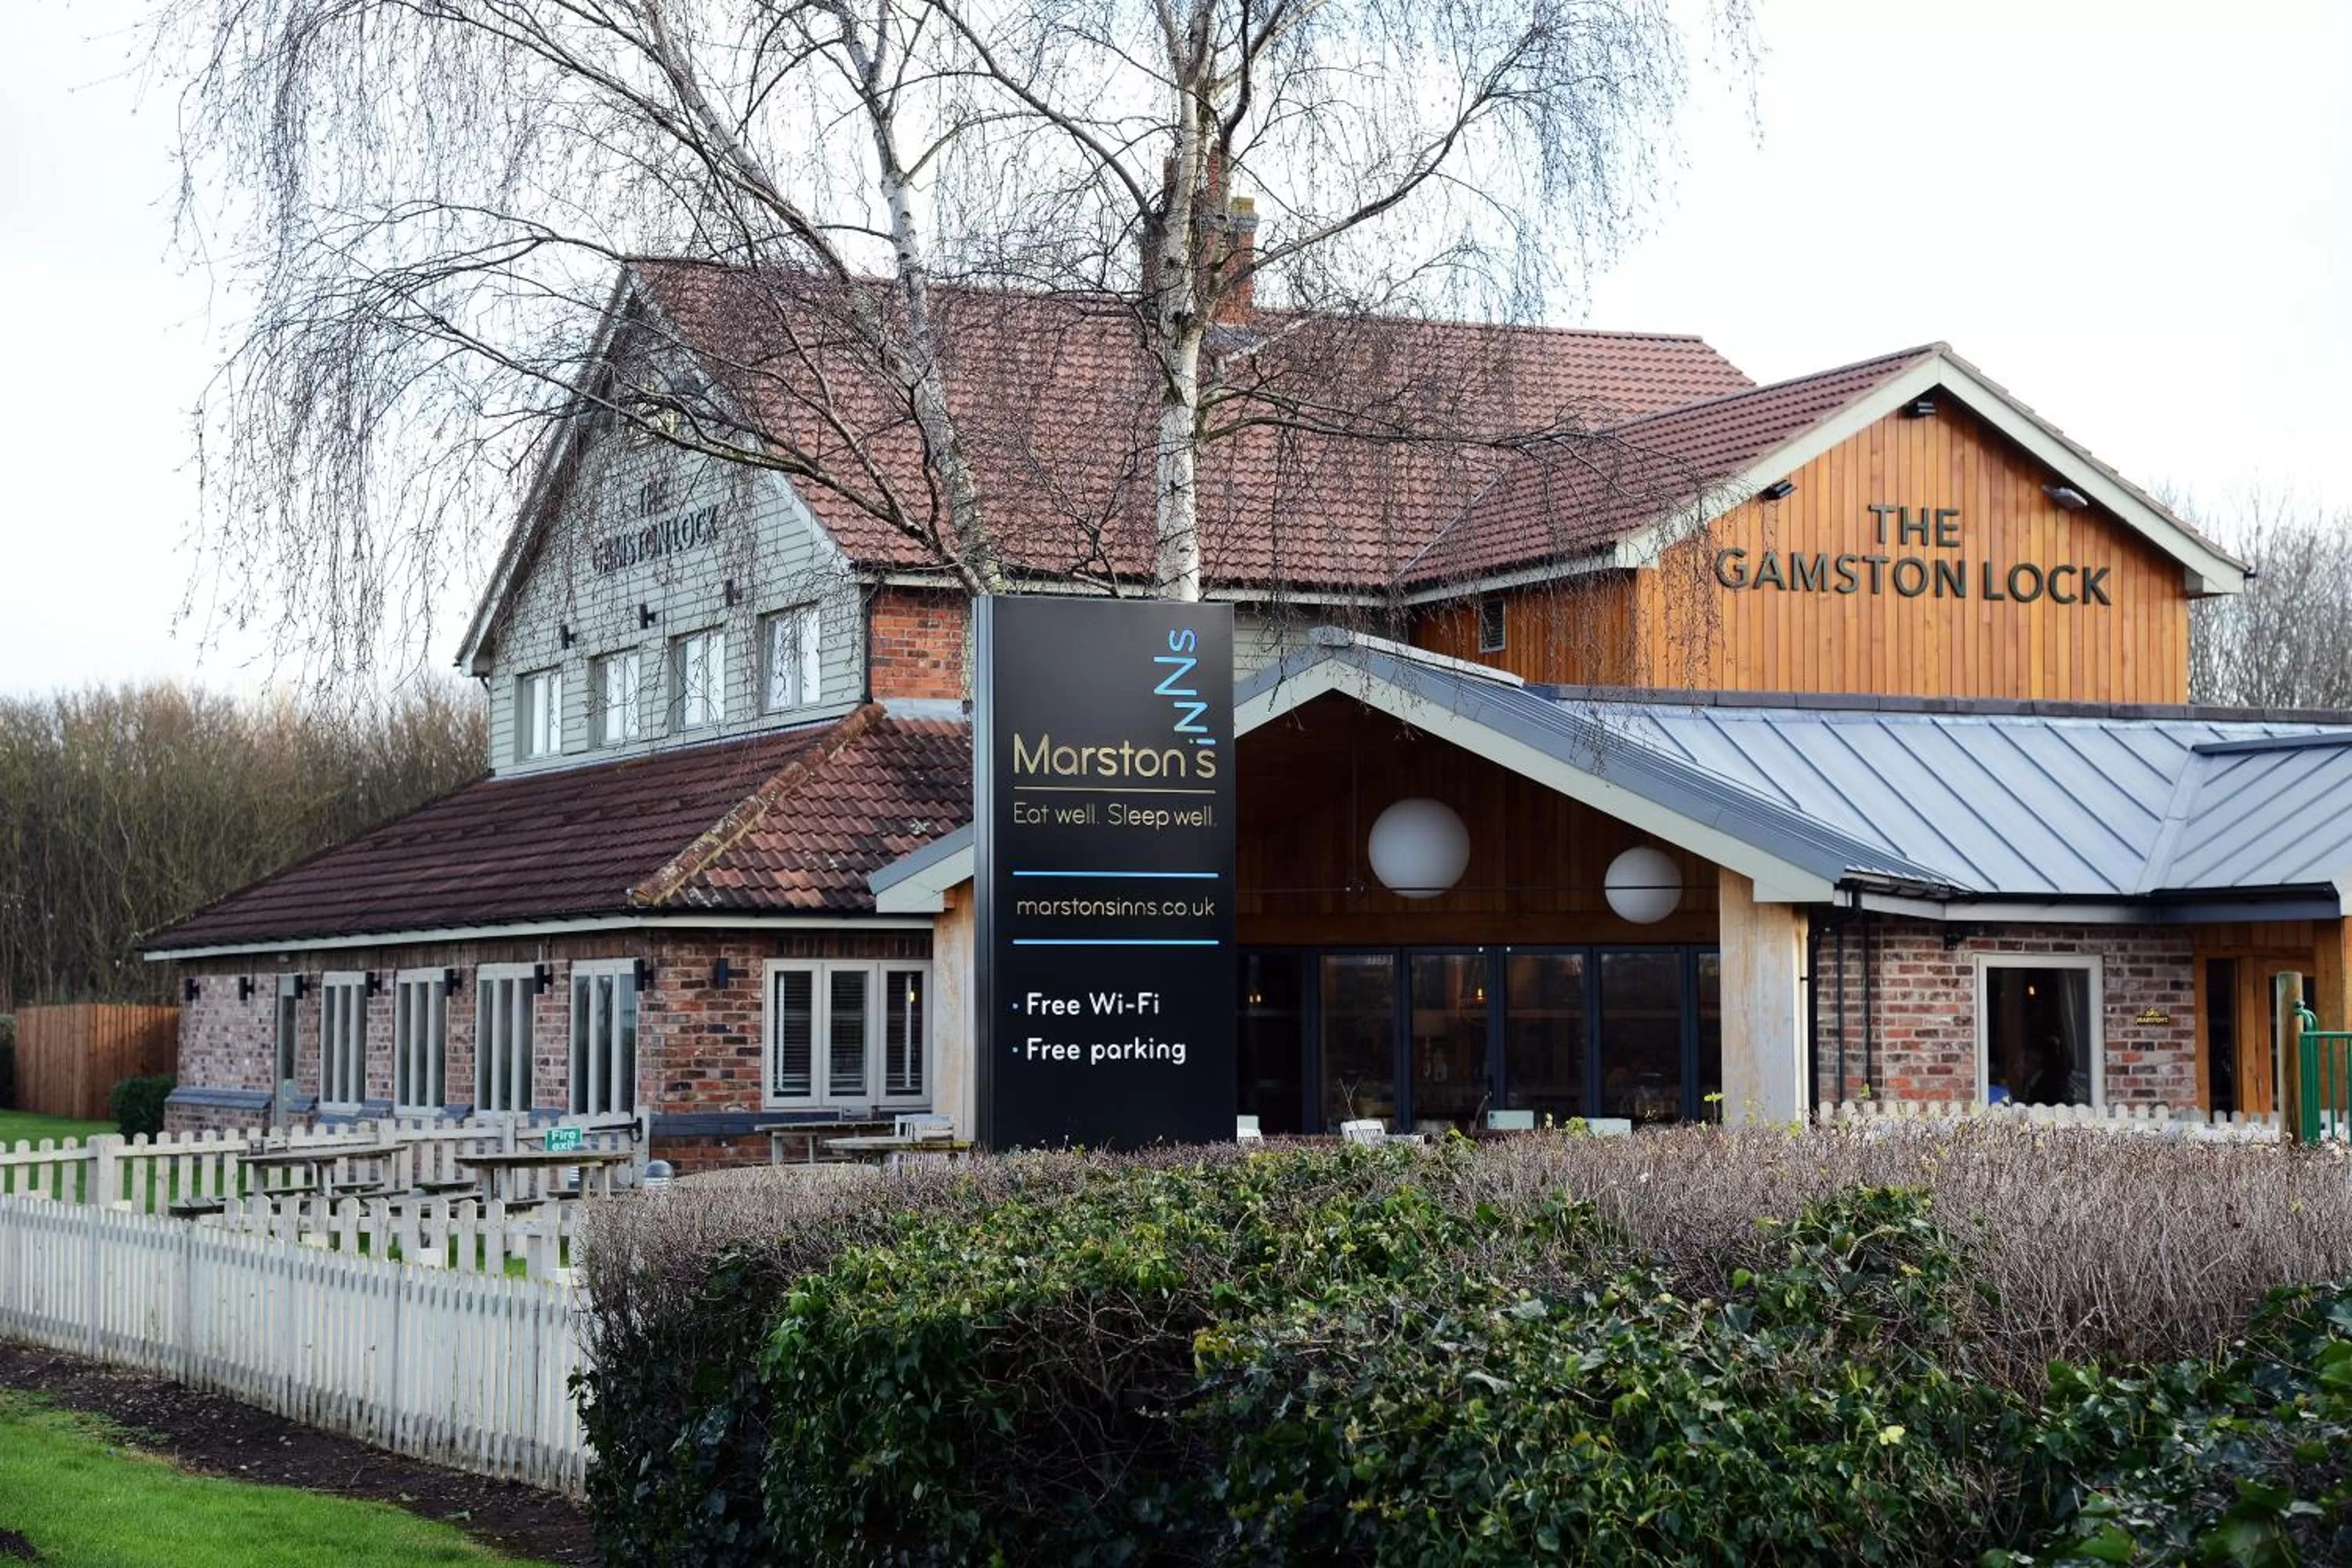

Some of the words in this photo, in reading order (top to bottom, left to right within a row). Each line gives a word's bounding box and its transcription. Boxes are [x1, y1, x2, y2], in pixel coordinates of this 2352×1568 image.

[1868, 504, 1961, 547] THE
[1715, 547, 1967, 598] GAMSTON
[1984, 560, 2111, 606] LOCK
[1013, 802, 1049, 824] Eat
[1108, 803, 1170, 830] Sleep
[1017, 896, 1215, 916] marstonsinns.co.uk
[1026, 992, 1081, 1015] Free
[1089, 992, 1160, 1015] Wi-Fi
[1026, 1037, 1081, 1060] Free
[1091, 1036, 1186, 1065] parking
[551, 1129, 577, 1141] Fire
